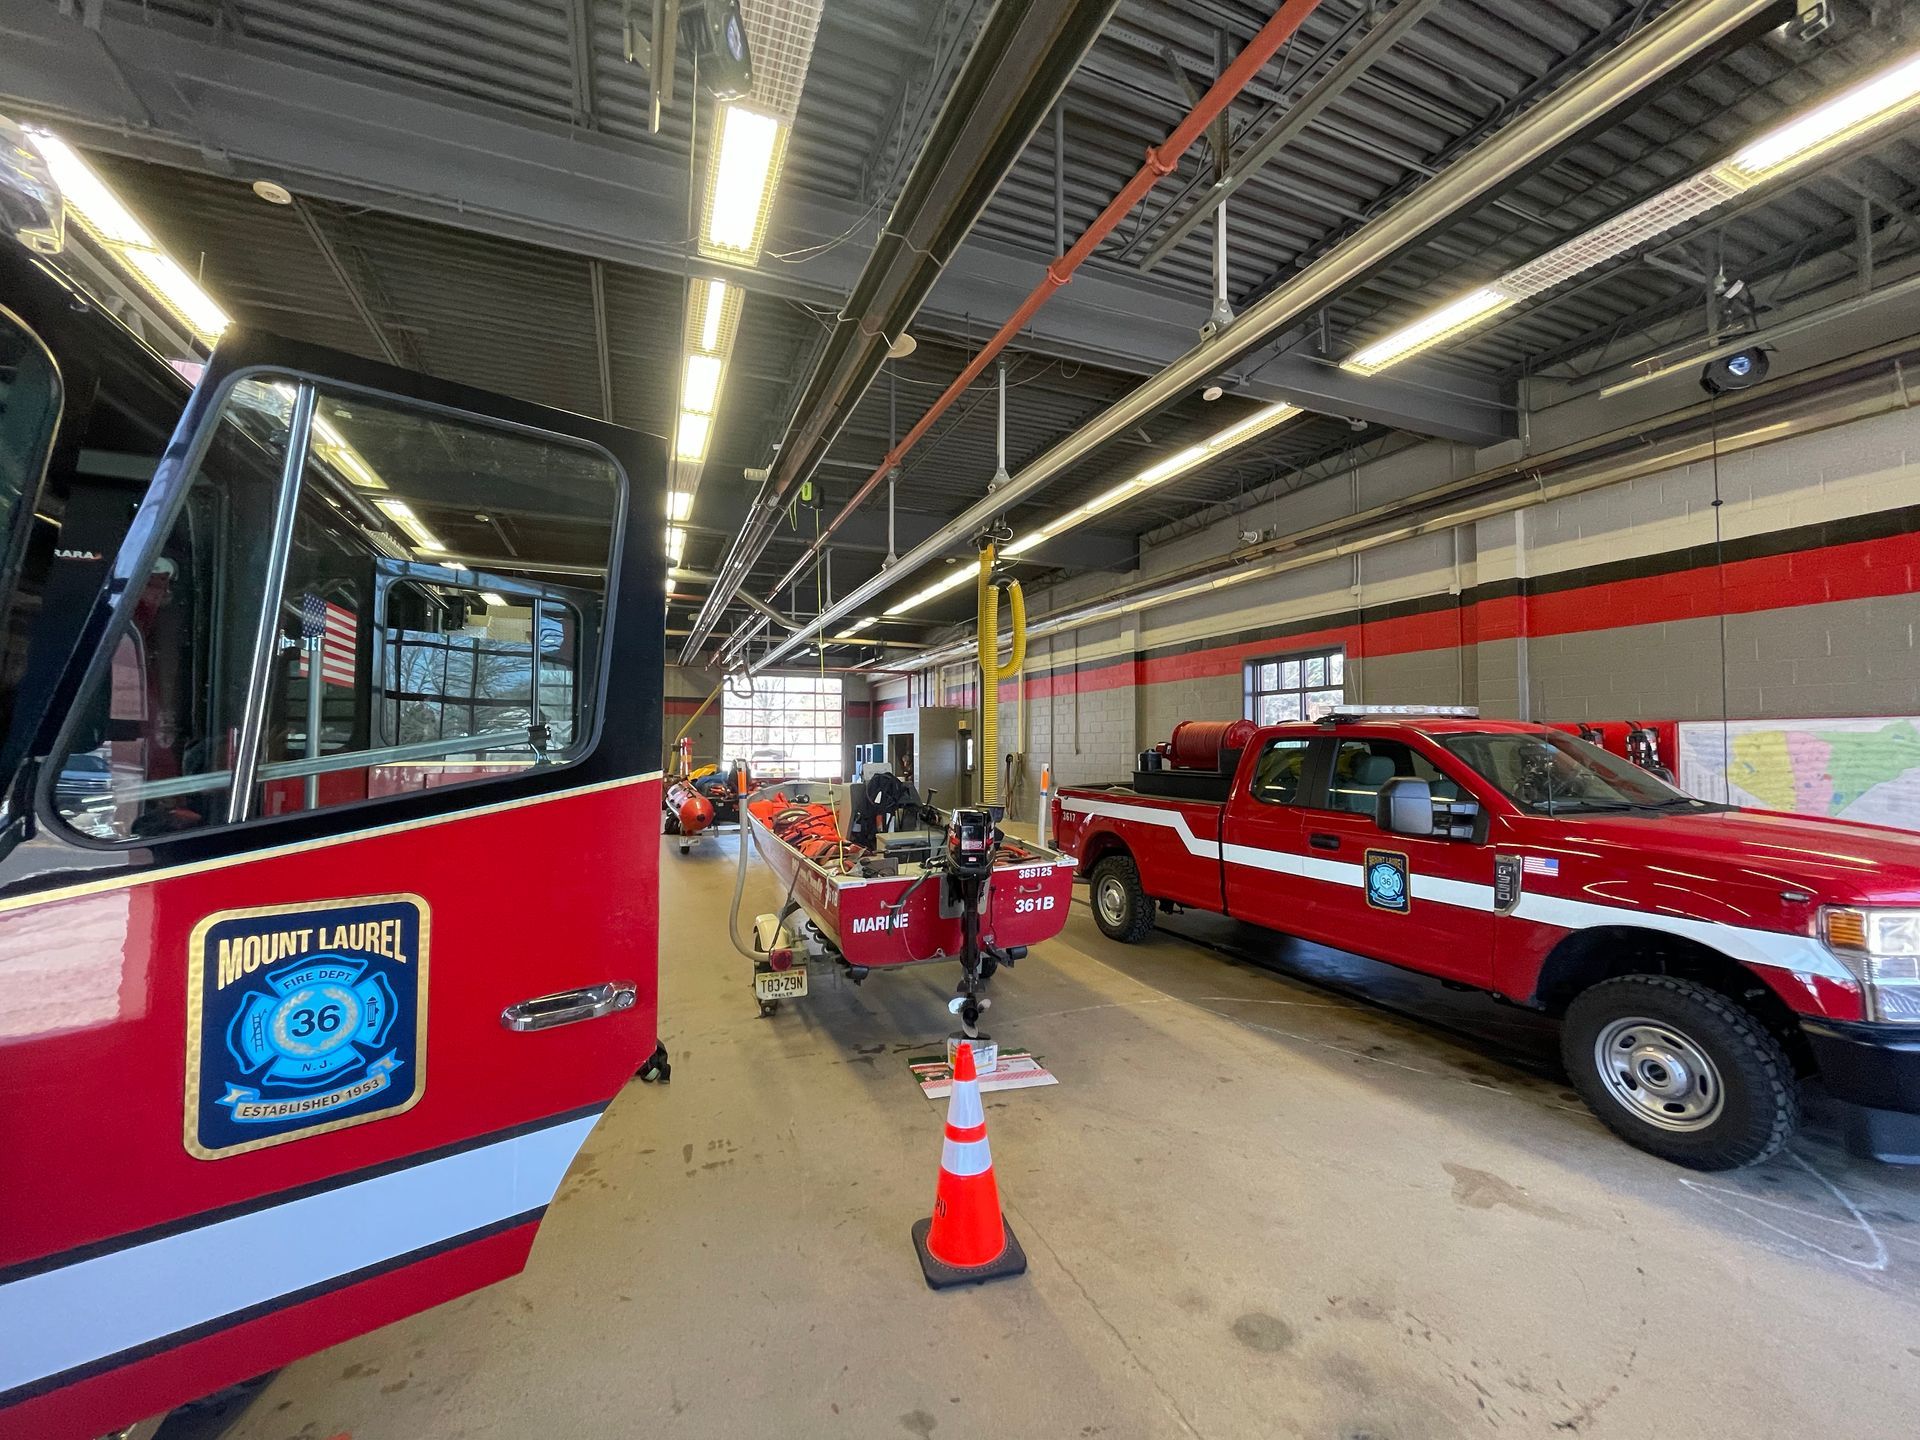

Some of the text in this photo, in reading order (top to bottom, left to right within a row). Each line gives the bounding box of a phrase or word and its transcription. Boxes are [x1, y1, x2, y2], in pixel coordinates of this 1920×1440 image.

[1018, 866, 1053, 879] 36S125
[1381, 877, 1392, 886] 36
[1014, 896, 1055, 913] 361B
[852, 913, 909, 934] MARINE
[217, 919, 407, 991] MOUNT LAUREL
[283, 972, 314, 990] FIRE
[291, 1004, 341, 1037] 36
[242, 1079, 380, 1117] ESTABLISHED 1953
